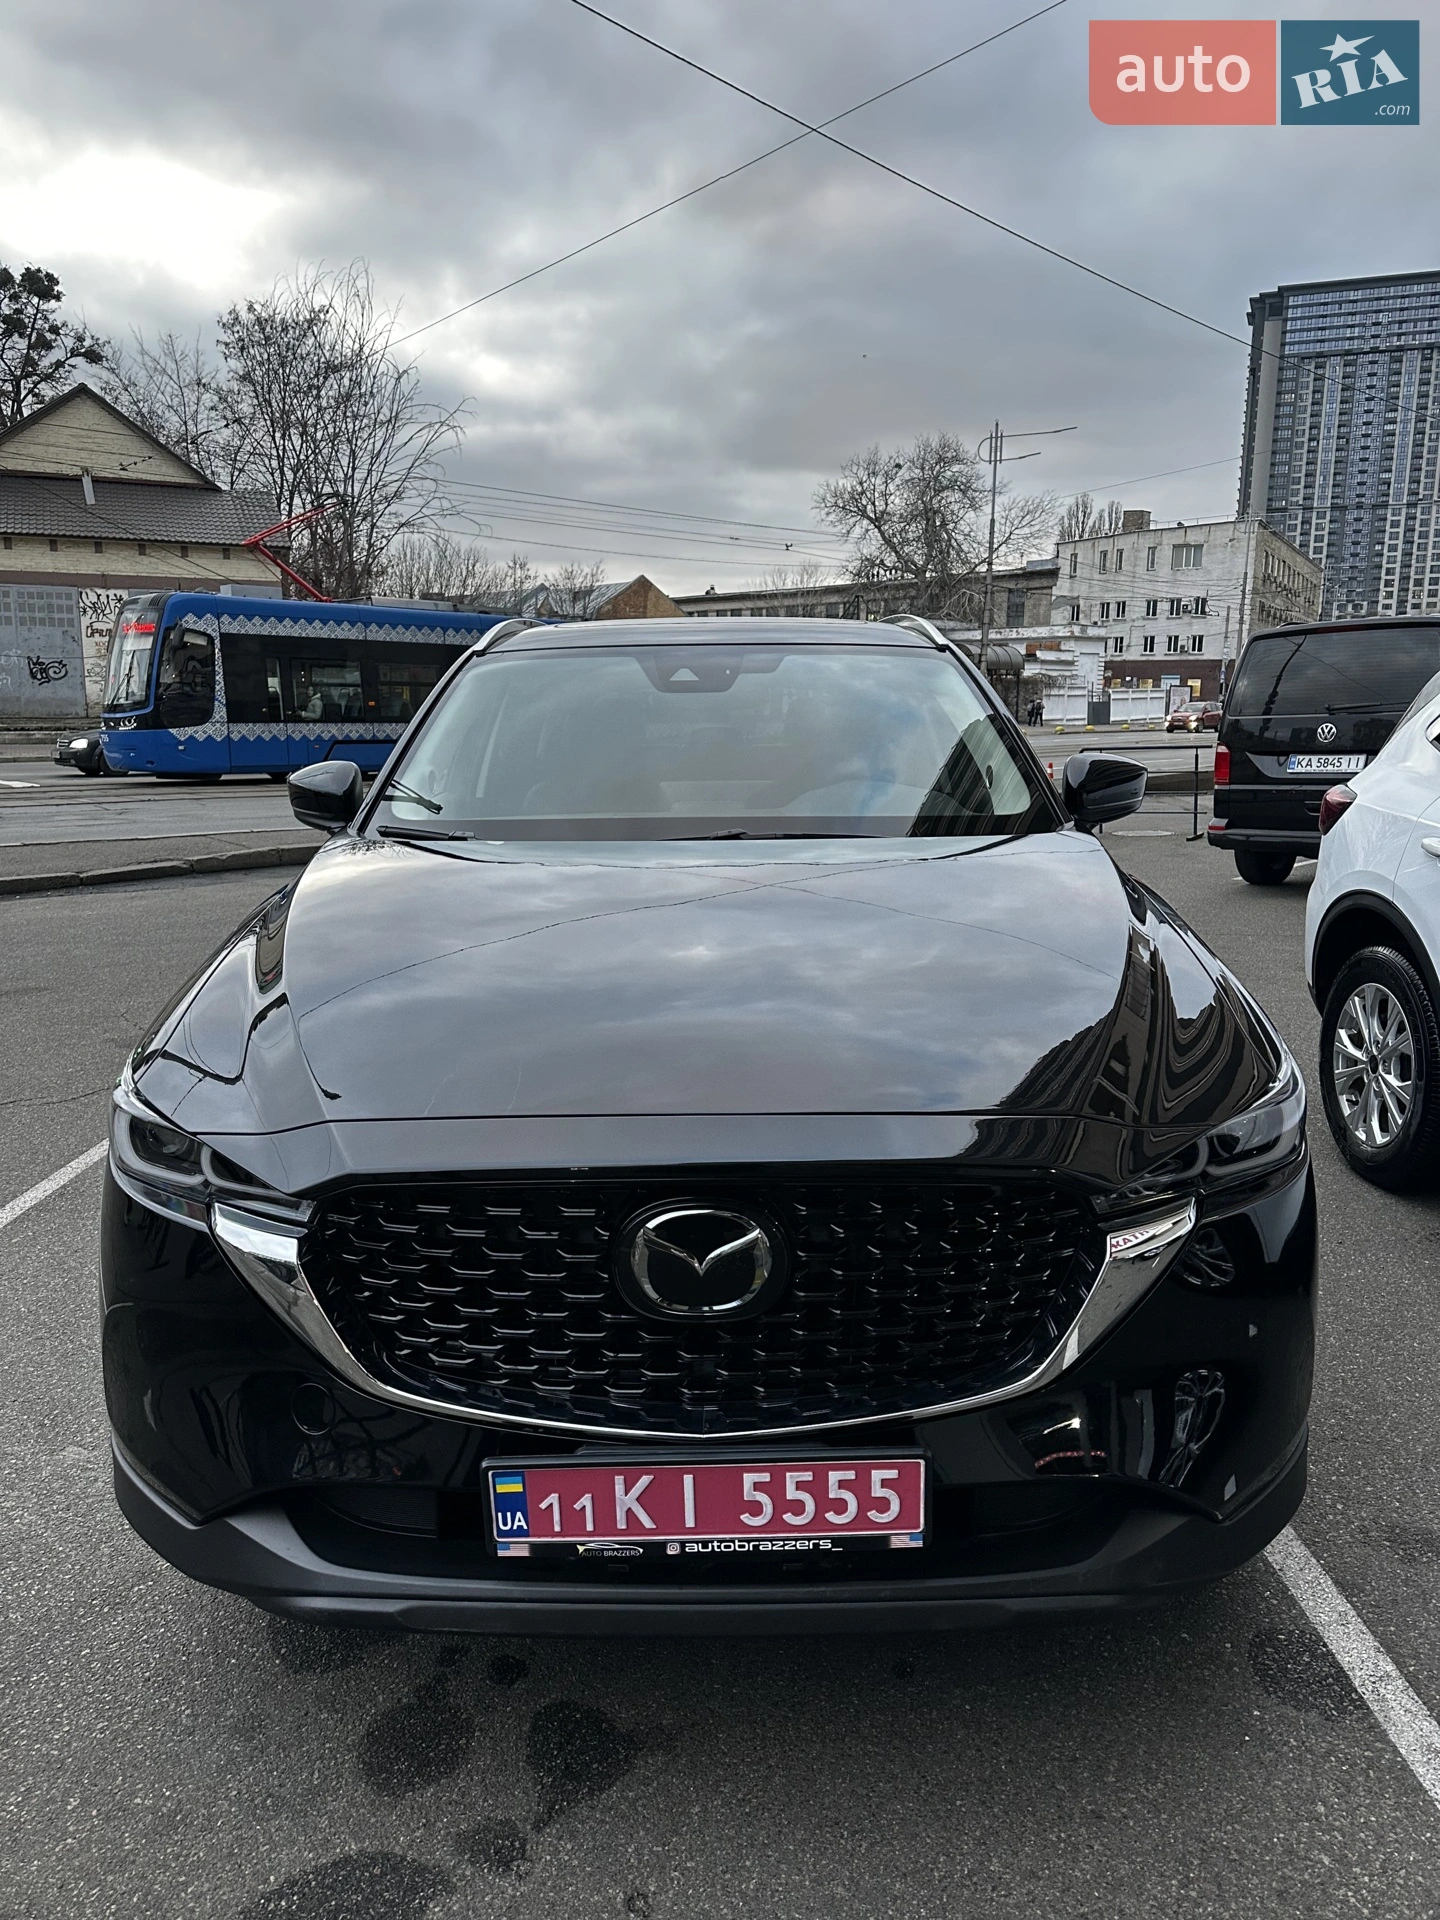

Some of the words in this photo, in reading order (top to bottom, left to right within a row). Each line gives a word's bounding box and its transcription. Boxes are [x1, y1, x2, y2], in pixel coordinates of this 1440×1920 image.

[1296, 757, 1313, 768] KA
[1316, 757, 1343, 768] 5845
[739, 1469, 901, 1528] 5555
[498, 1511, 528, 1531] UA
